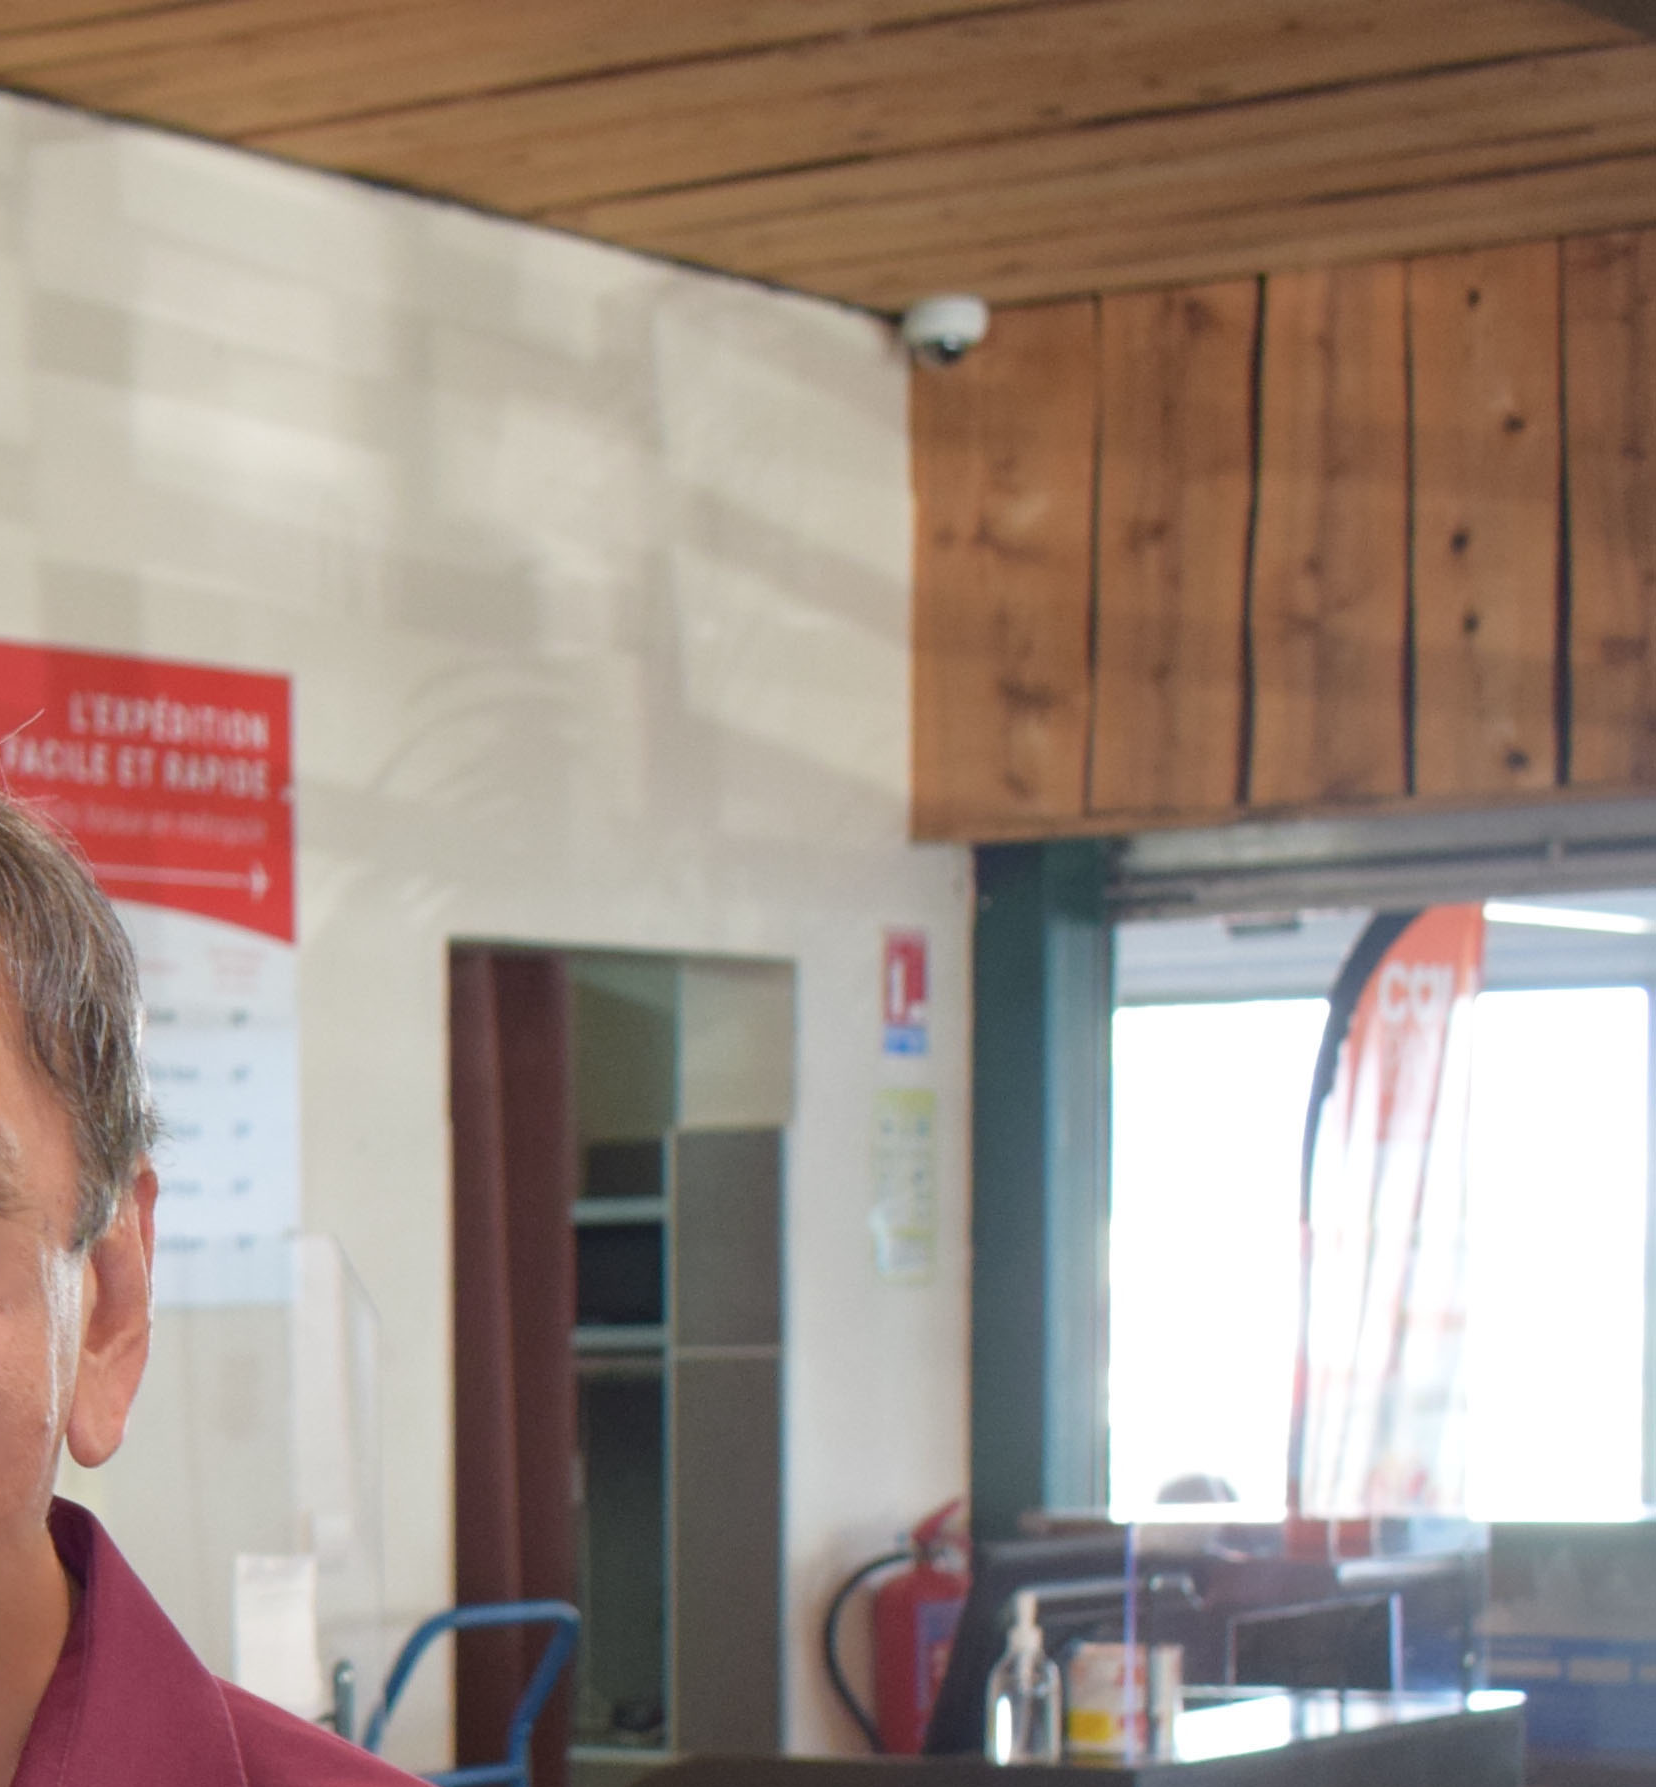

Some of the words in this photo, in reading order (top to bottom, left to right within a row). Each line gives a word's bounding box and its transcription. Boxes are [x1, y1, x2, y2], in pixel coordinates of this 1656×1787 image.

[68, 690, 270, 750] L'EXPÉDITION
[2, 737, 109, 787] FACILE
[115, 745, 155, 790] ET
[162, 750, 270, 801] RAPIDE
